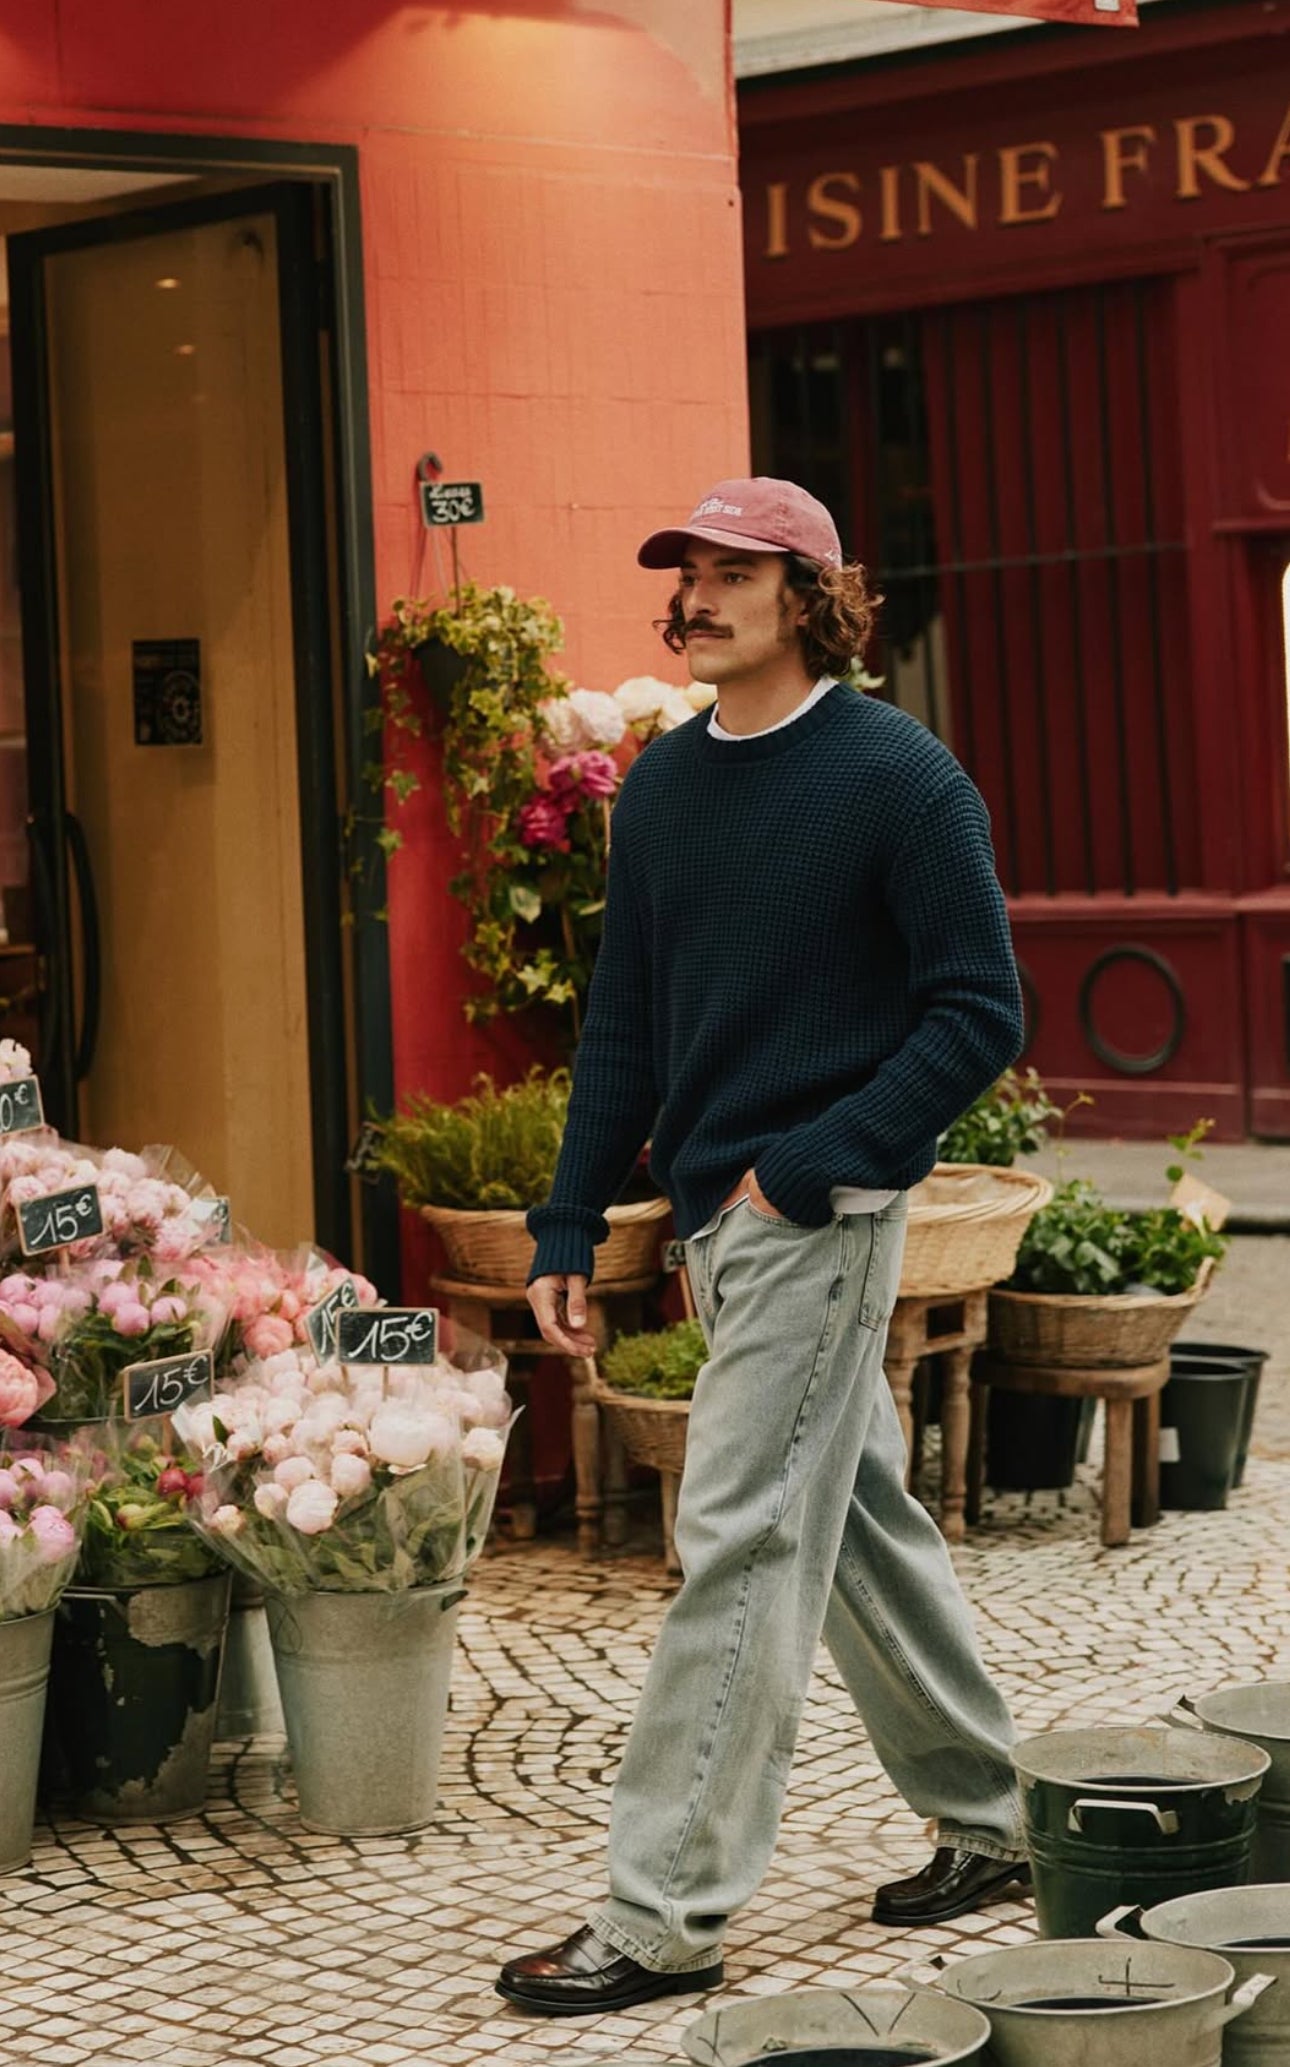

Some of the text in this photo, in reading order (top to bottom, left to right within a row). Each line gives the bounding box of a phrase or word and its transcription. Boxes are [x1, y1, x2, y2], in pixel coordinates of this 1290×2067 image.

[764, 142, 1062, 257] ISINE
[431, 497, 476, 523] 30€
[30, 1193, 93, 1246] 15€
[347, 1311, 433, 1361] 15€
[134, 1355, 209, 1410] 15€
